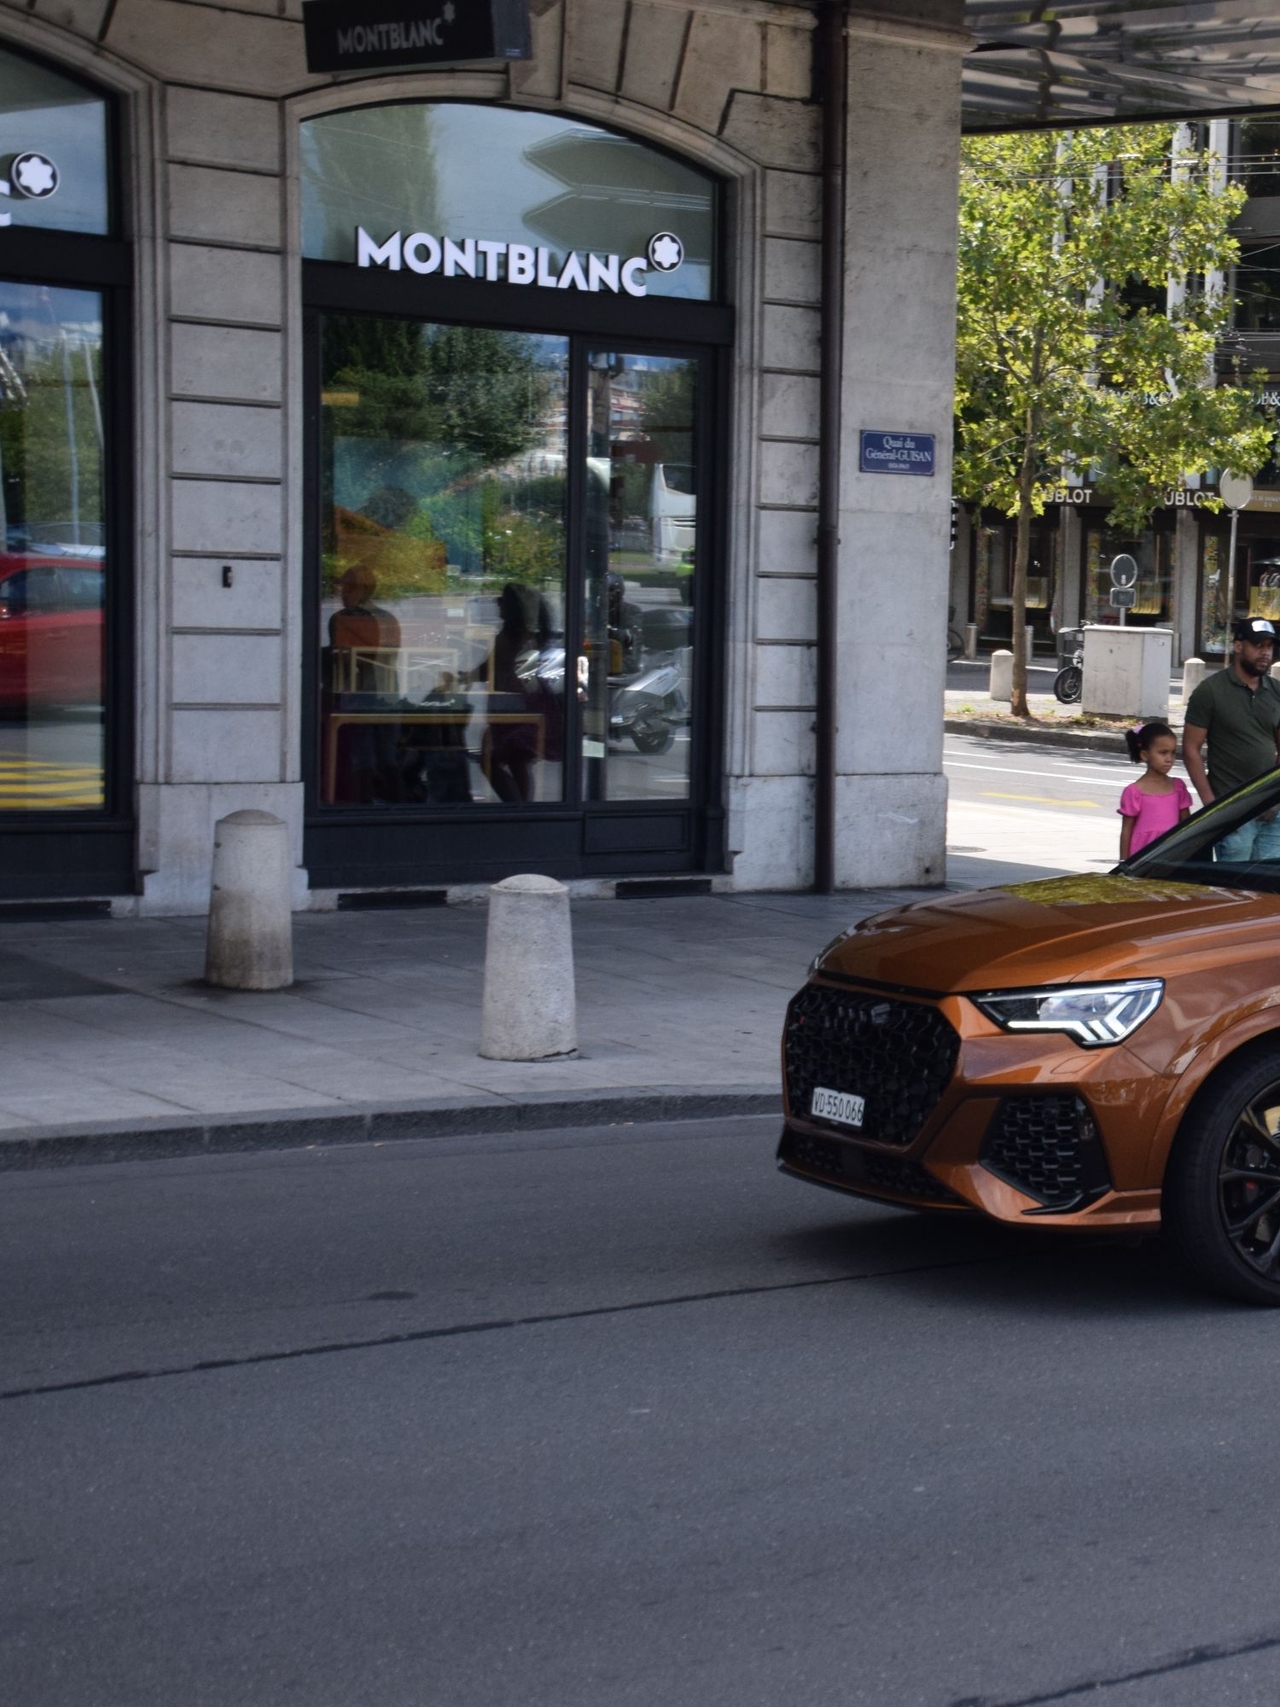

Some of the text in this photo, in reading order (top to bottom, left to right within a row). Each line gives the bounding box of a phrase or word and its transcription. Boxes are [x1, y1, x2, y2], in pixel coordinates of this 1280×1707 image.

[336, 17, 444, 55] MONTBLANC
[356, 225, 648, 297] MONTBLANC
[882, 436, 915, 449] Quai du
[1043, 488, 1093, 503] UBLOT
